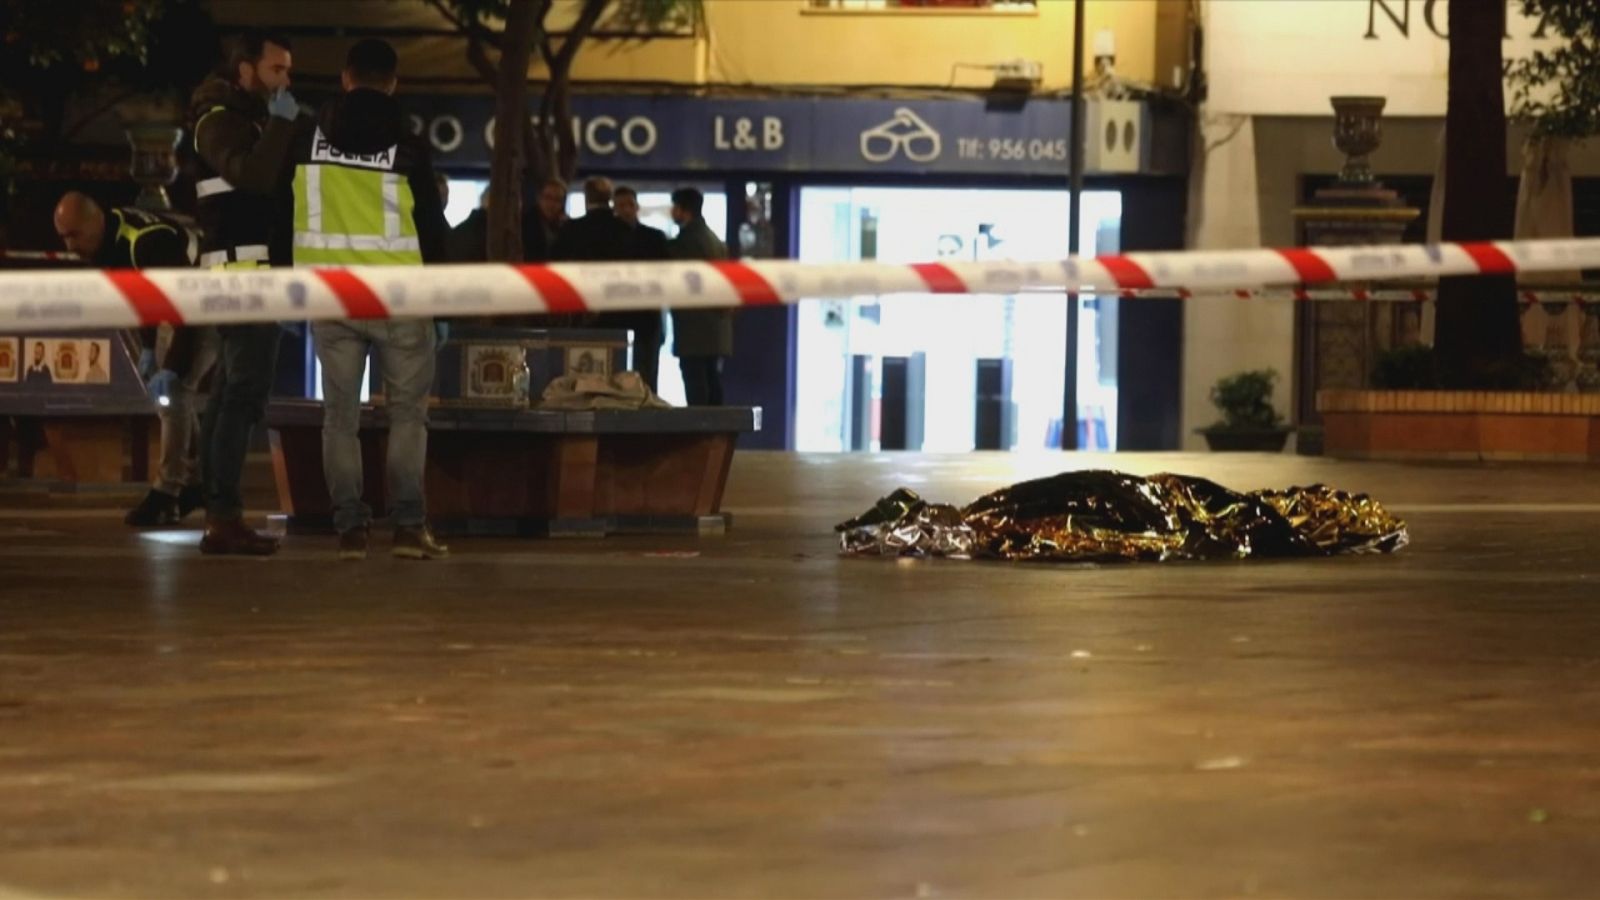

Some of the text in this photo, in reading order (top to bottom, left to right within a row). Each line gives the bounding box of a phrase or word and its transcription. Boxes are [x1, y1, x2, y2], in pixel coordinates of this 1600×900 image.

[714, 115, 784, 150] L&B
[988, 137, 1025, 160] 956
[1029, 137, 1067, 160] 045
